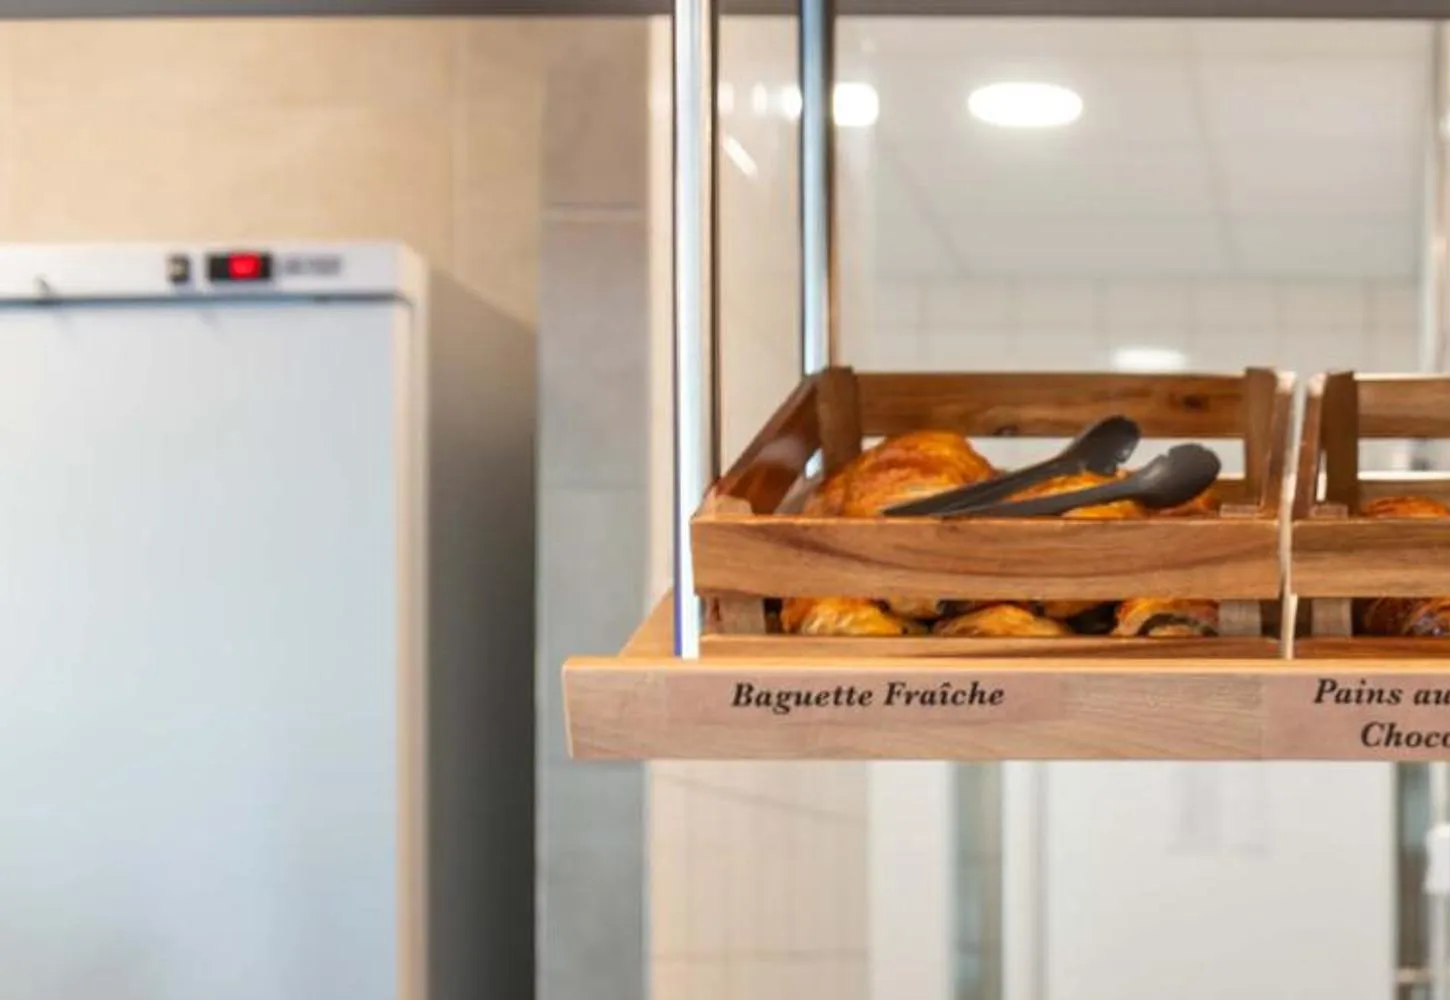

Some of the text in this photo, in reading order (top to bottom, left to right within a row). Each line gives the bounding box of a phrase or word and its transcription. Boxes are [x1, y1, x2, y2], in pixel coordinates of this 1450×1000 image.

[731, 681, 1005, 715] Baguette Fraîche
[1313, 678, 1403, 705] Pains
